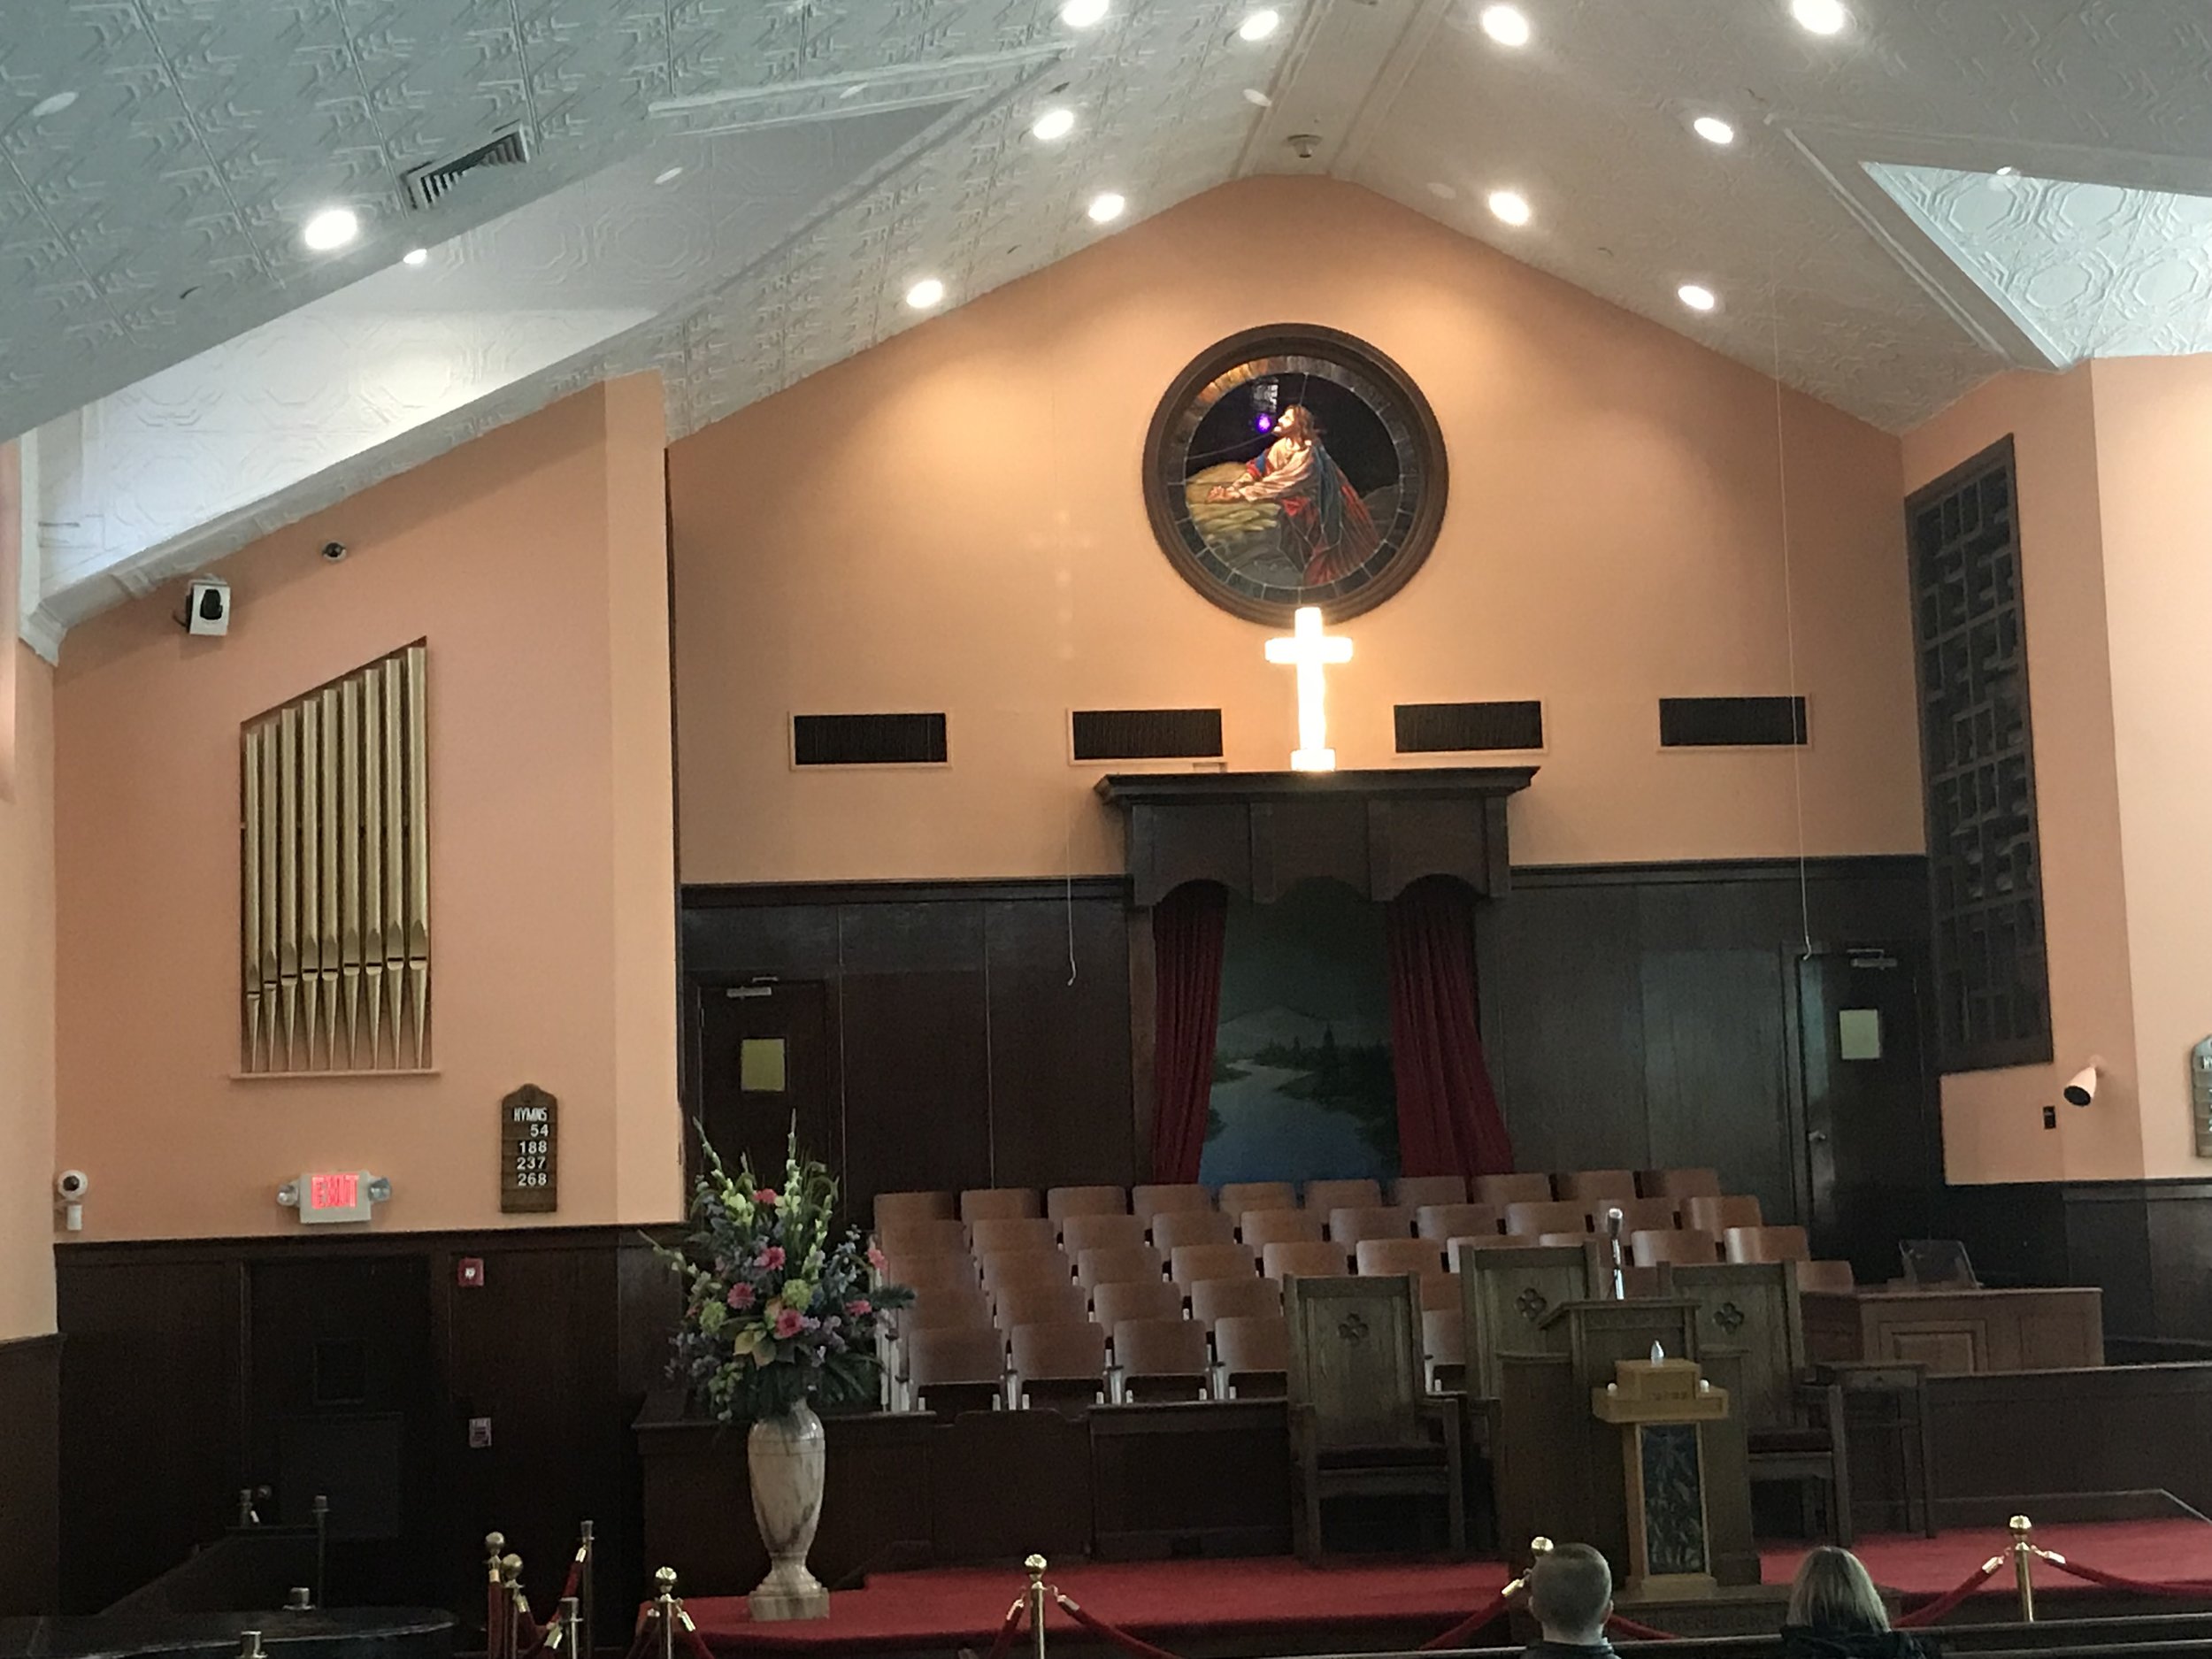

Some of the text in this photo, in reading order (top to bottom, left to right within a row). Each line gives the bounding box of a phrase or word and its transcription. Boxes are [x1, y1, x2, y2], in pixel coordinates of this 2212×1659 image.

[530, 1124, 549, 1137] 54
[519, 1141, 547, 1154] 188
[517, 1156, 546, 1170] 237
[518, 1172, 547, 1187] 268
